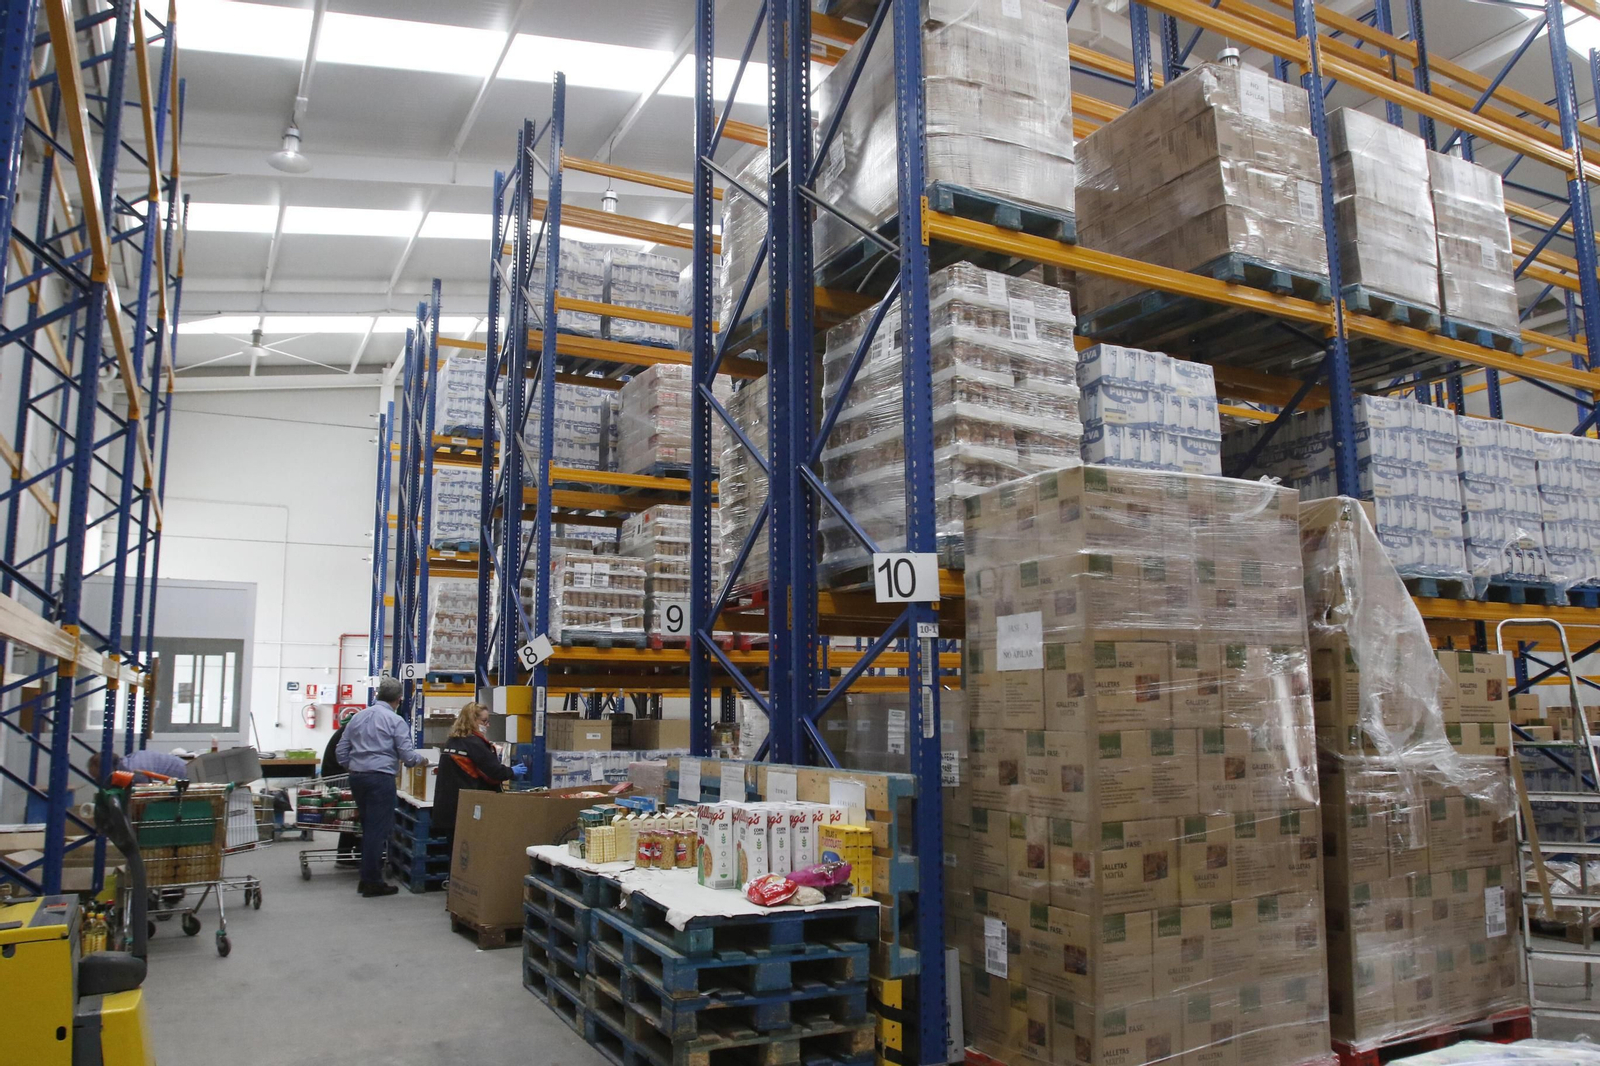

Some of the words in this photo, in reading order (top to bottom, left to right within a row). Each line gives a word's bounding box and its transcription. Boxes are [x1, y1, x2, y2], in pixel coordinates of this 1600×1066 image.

[1250, 82, 1259, 90] NO
[1245, 90, 1265, 102] APILAR
[1109, 386, 1144, 399] PULEVA
[1187, 440, 1217, 452] PULEVA
[1293, 441, 1324, 456] PULEVA
[1377, 465, 1403, 475] PULEVA
[1436, 508, 1459, 517] PULEVA
[1383, 534, 1409, 544] PULEVA
[878, 558, 916, 598] 10
[666, 604, 684, 633] 9
[920, 625, 937, 634] 10-1
[1024, 622, 1029, 631] 3
[523, 646, 538, 665] 8
[1003, 650, 1012, 659] NO
[1013, 649, 1034, 659] APILAR
[405, 664, 415, 678] 6
[697, 804, 725, 826] Kellogg's
[1194, 873, 1219, 881] GALLETAS
[1168, 965, 1194, 975] GALLETAS
